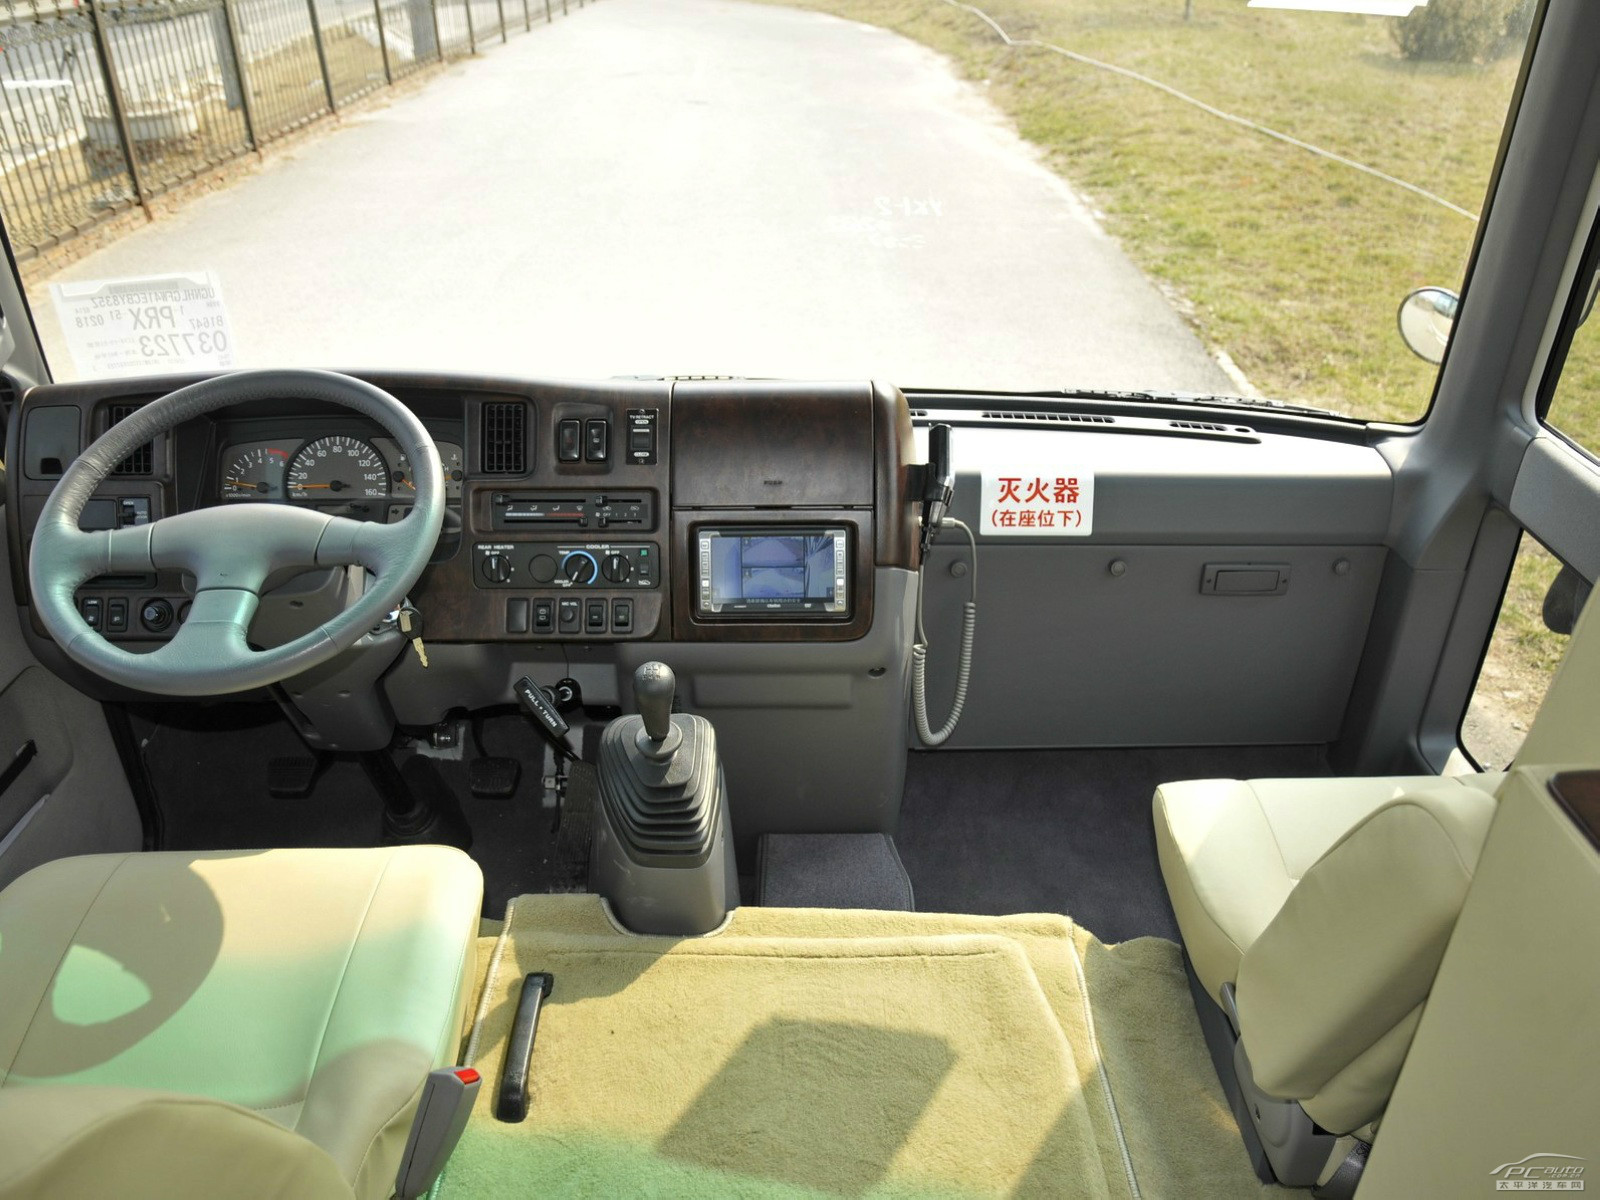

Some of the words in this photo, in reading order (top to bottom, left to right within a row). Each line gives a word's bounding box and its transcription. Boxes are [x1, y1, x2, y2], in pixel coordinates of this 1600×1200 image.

[998, 478, 1079, 503] 灭火器
[525, 689, 539, 706] PULL
[542, 710, 557, 727] TURN
